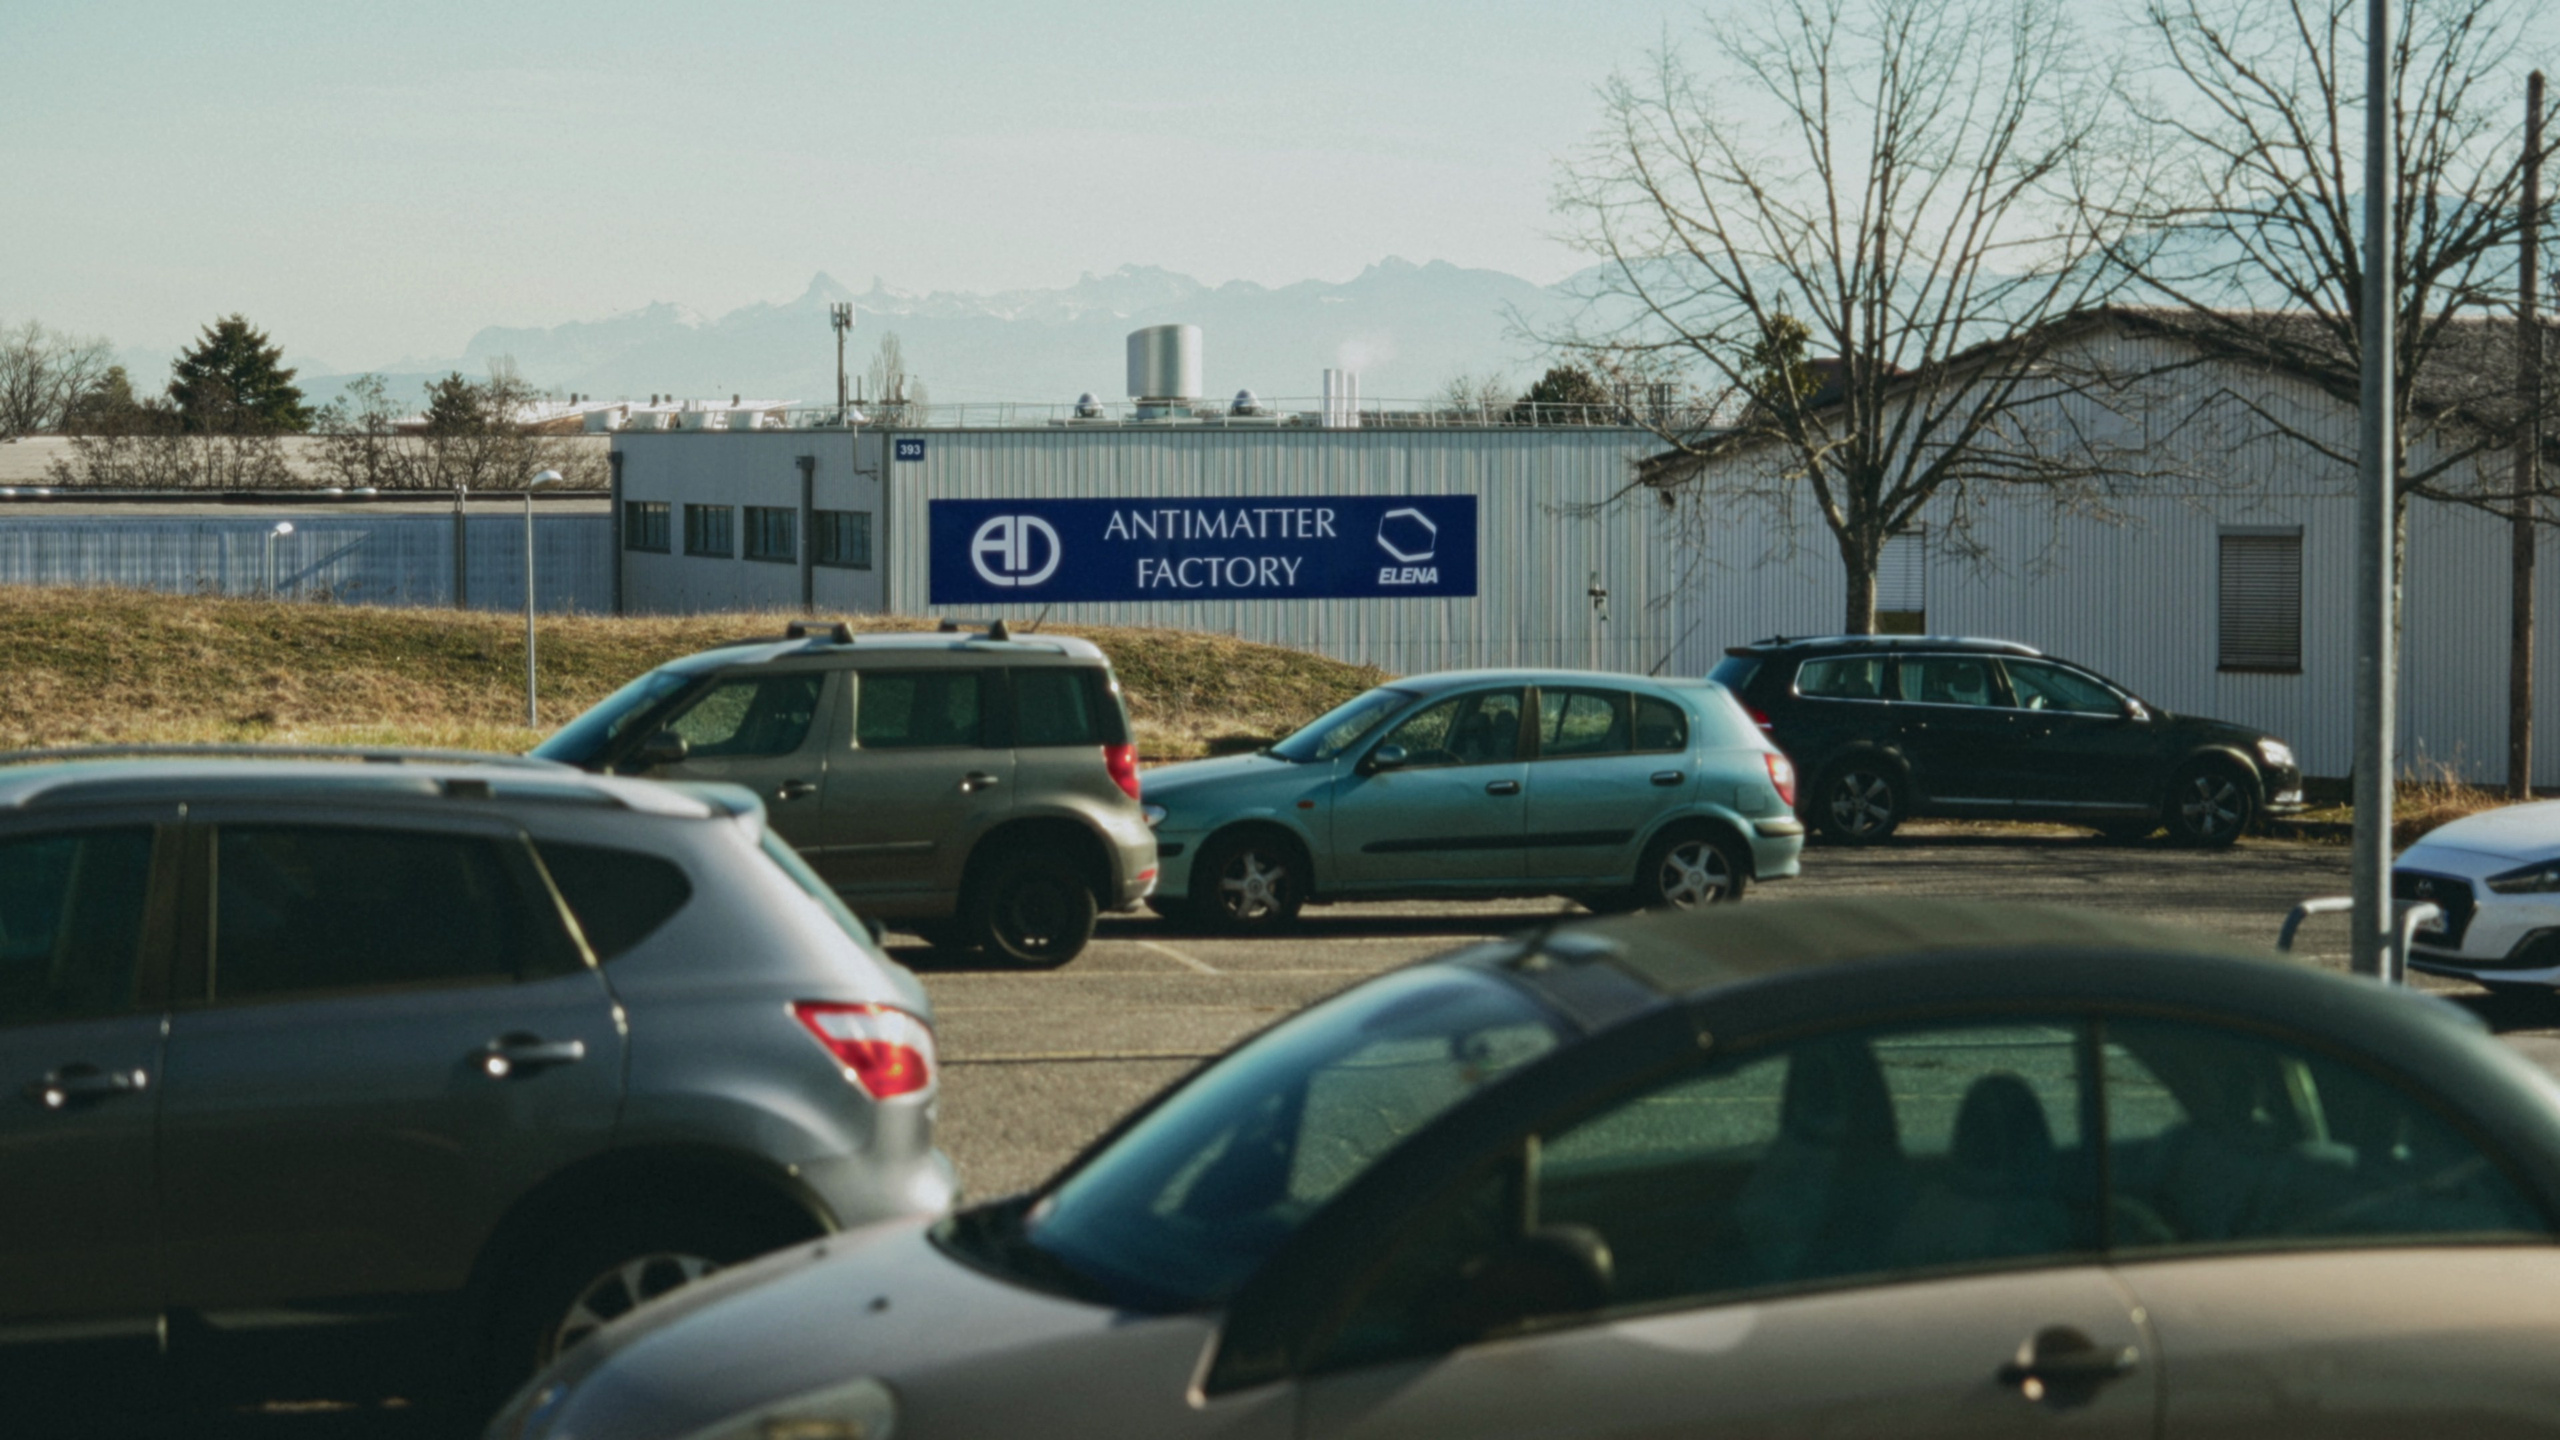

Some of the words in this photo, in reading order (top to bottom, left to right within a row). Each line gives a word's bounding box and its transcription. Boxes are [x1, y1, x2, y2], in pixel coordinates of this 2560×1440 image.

[900, 444, 922, 455] 393
[1104, 508, 1337, 540] ANTIMATTER
[1137, 556, 1303, 588] FACTORY
[1378, 567, 1439, 585] ELENA
